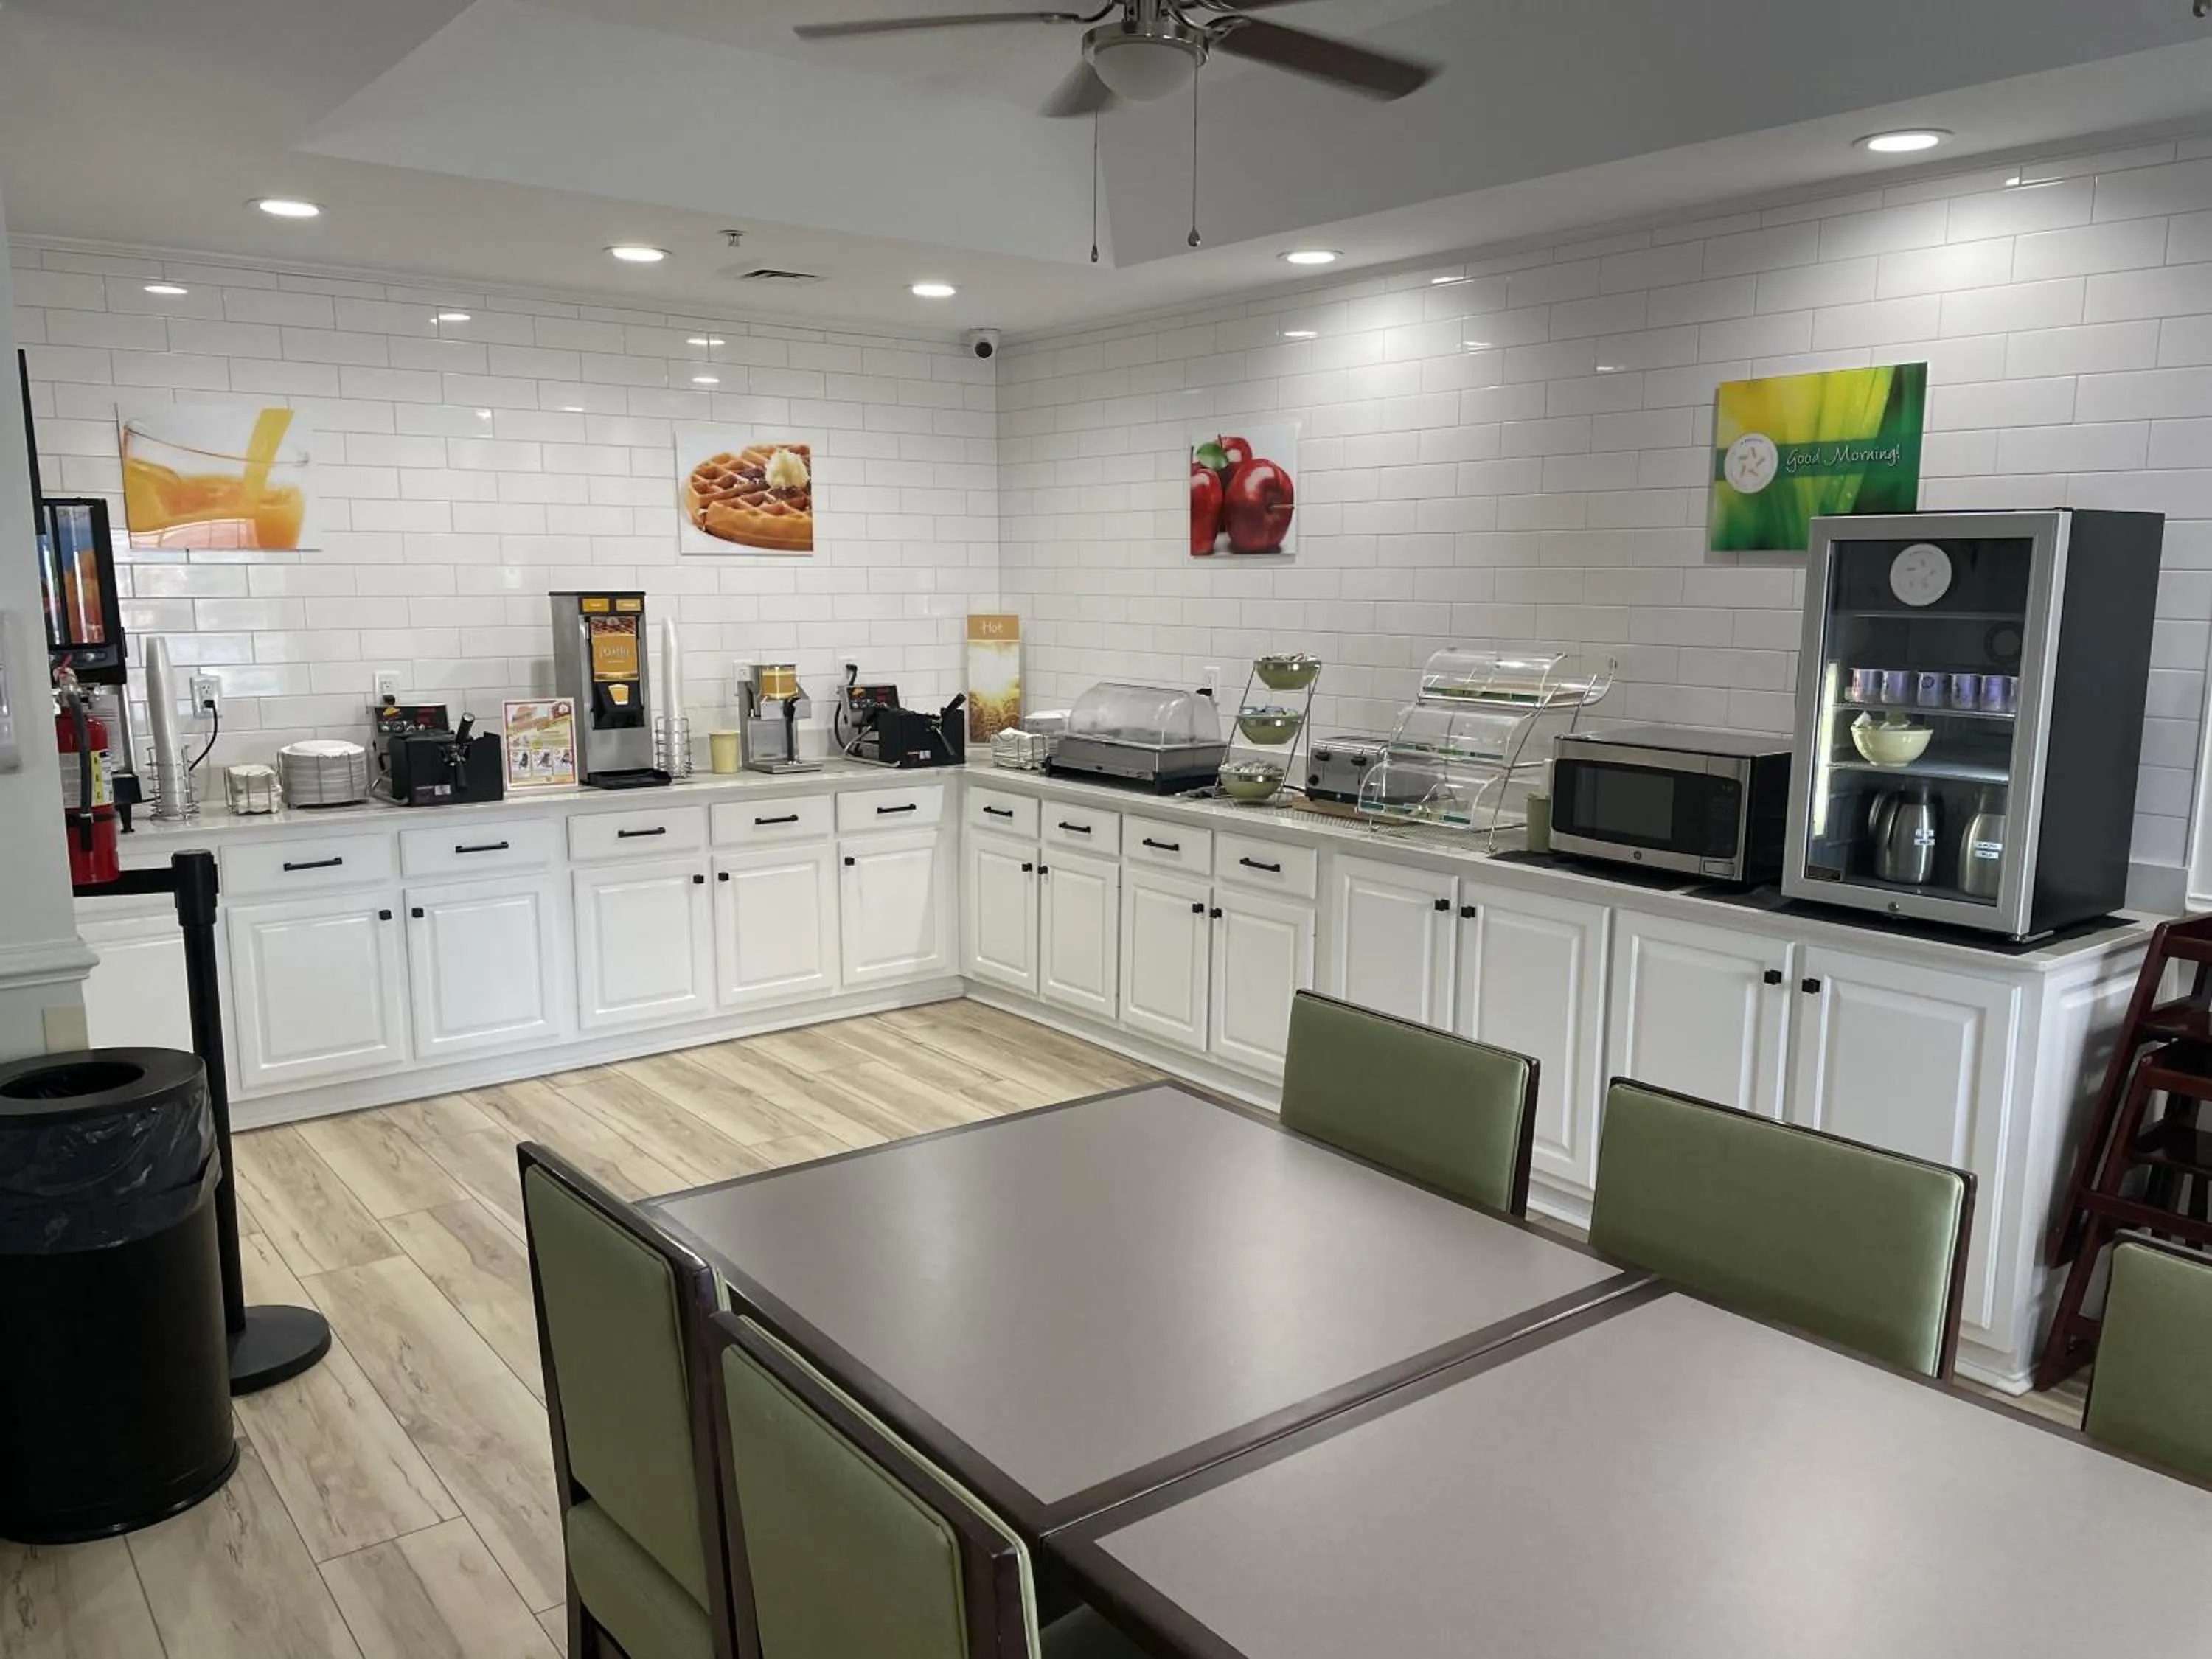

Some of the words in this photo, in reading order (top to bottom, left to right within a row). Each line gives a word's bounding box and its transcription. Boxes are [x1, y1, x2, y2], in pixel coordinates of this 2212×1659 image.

[1786, 448, 1820, 473] Good
[1823, 443, 1901, 467] Morning!
[981, 619, 1004, 635] Hot
